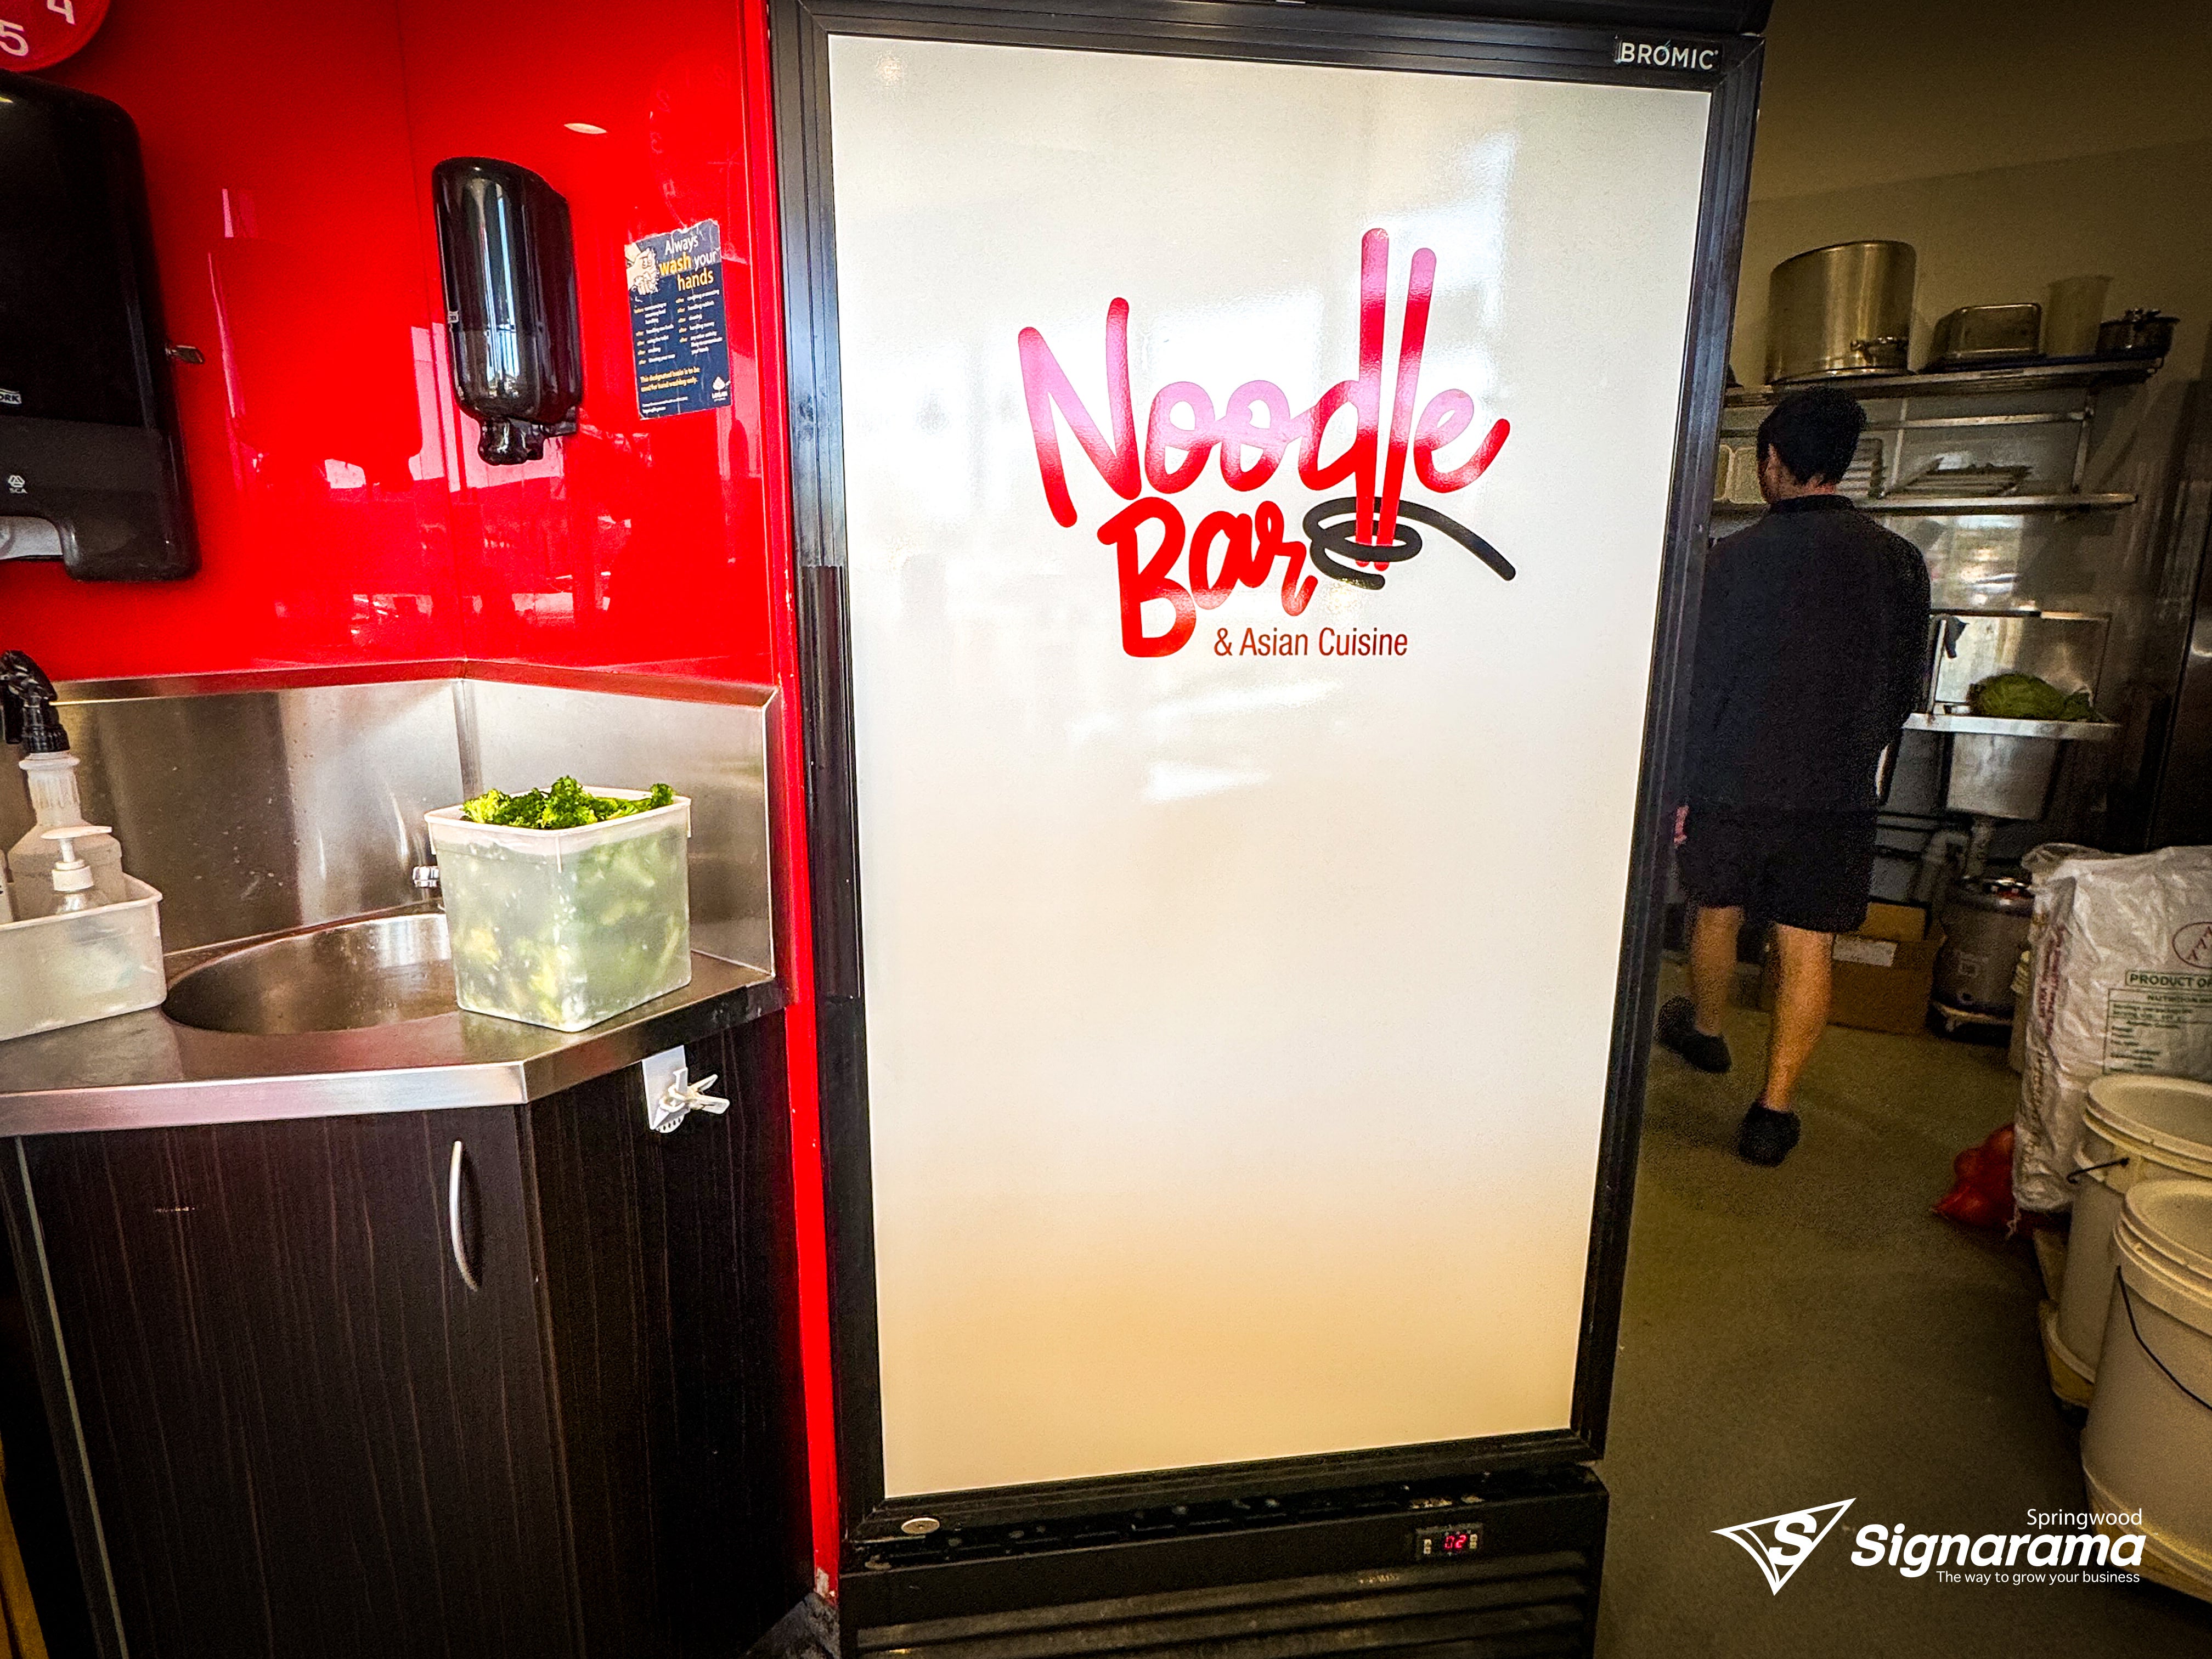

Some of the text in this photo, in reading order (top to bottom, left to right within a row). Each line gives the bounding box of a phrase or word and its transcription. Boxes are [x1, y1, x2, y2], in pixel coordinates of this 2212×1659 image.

[1621, 42, 1714, 70] BROMIC
[664, 235, 698, 255] Always
[659, 250, 717, 276] wash your
[678, 267, 713, 291] hands
[1018, 228, 1510, 571] Noodle
[1097, 496, 1318, 657] Bar
[1214, 627, 1408, 656] & Asian Cuisine
[2130, 973, 2194, 986] PRODUCT
